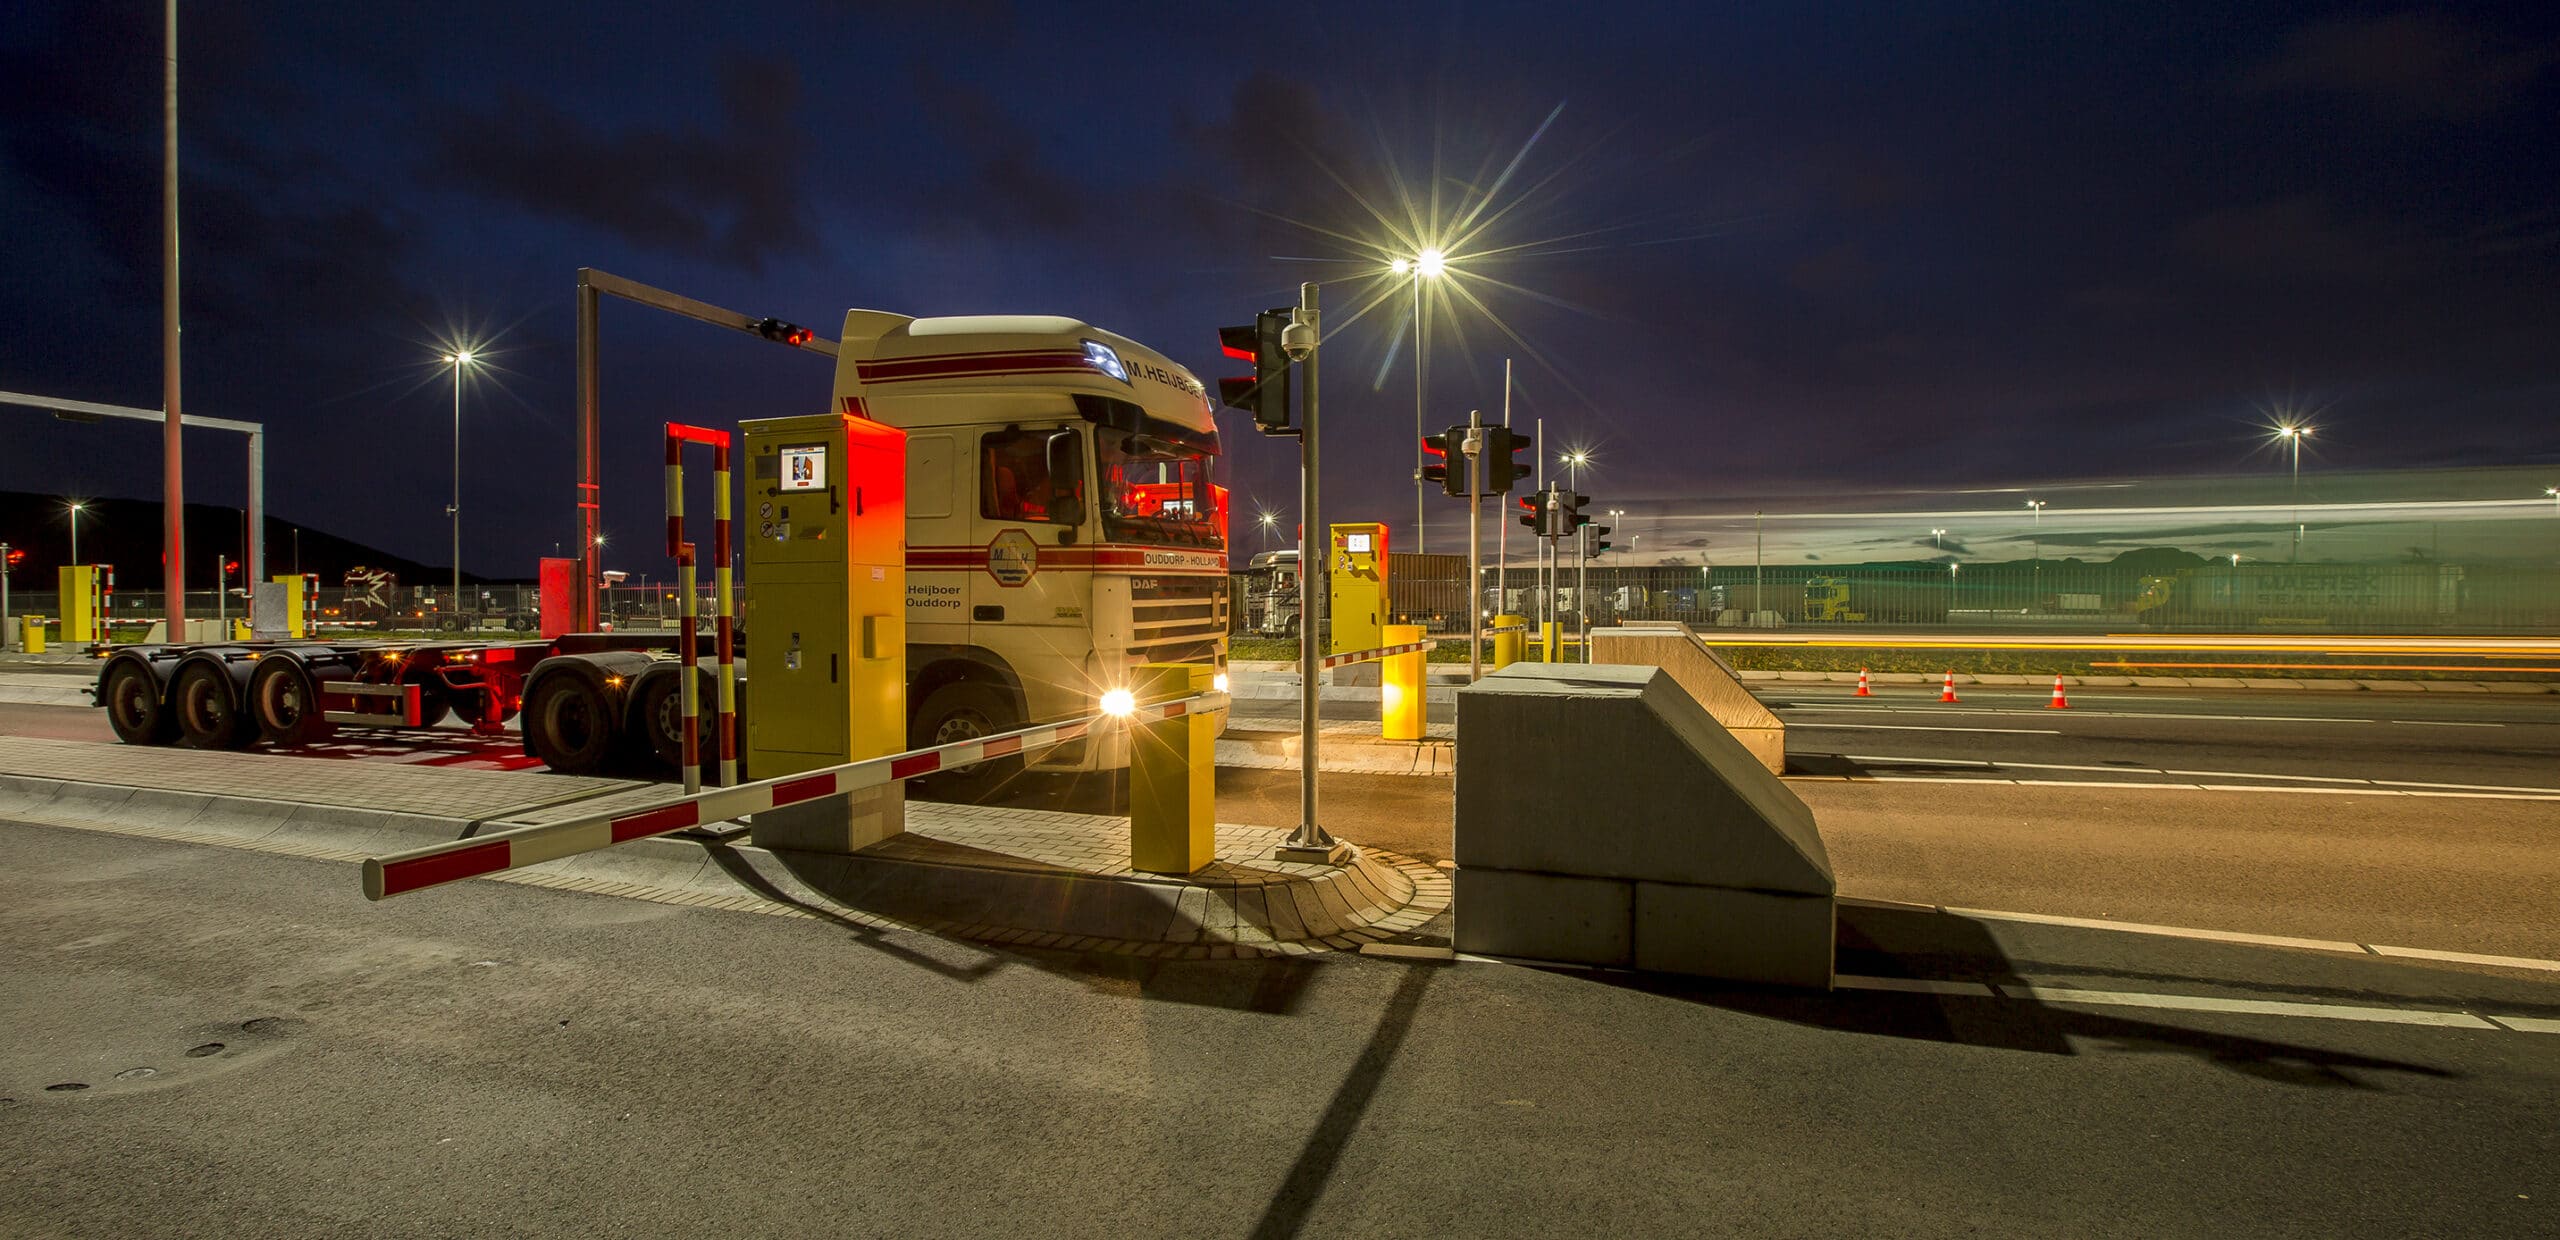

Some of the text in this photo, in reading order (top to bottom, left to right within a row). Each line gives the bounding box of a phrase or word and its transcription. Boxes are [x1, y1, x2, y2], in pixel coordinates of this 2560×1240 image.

[1145, 553, 1185, 566] OUDDORP
[1132, 579, 1158, 590] DAF
[2258, 574, 2378, 591] MAERSK
[905, 597, 961, 610] Ouddorp
